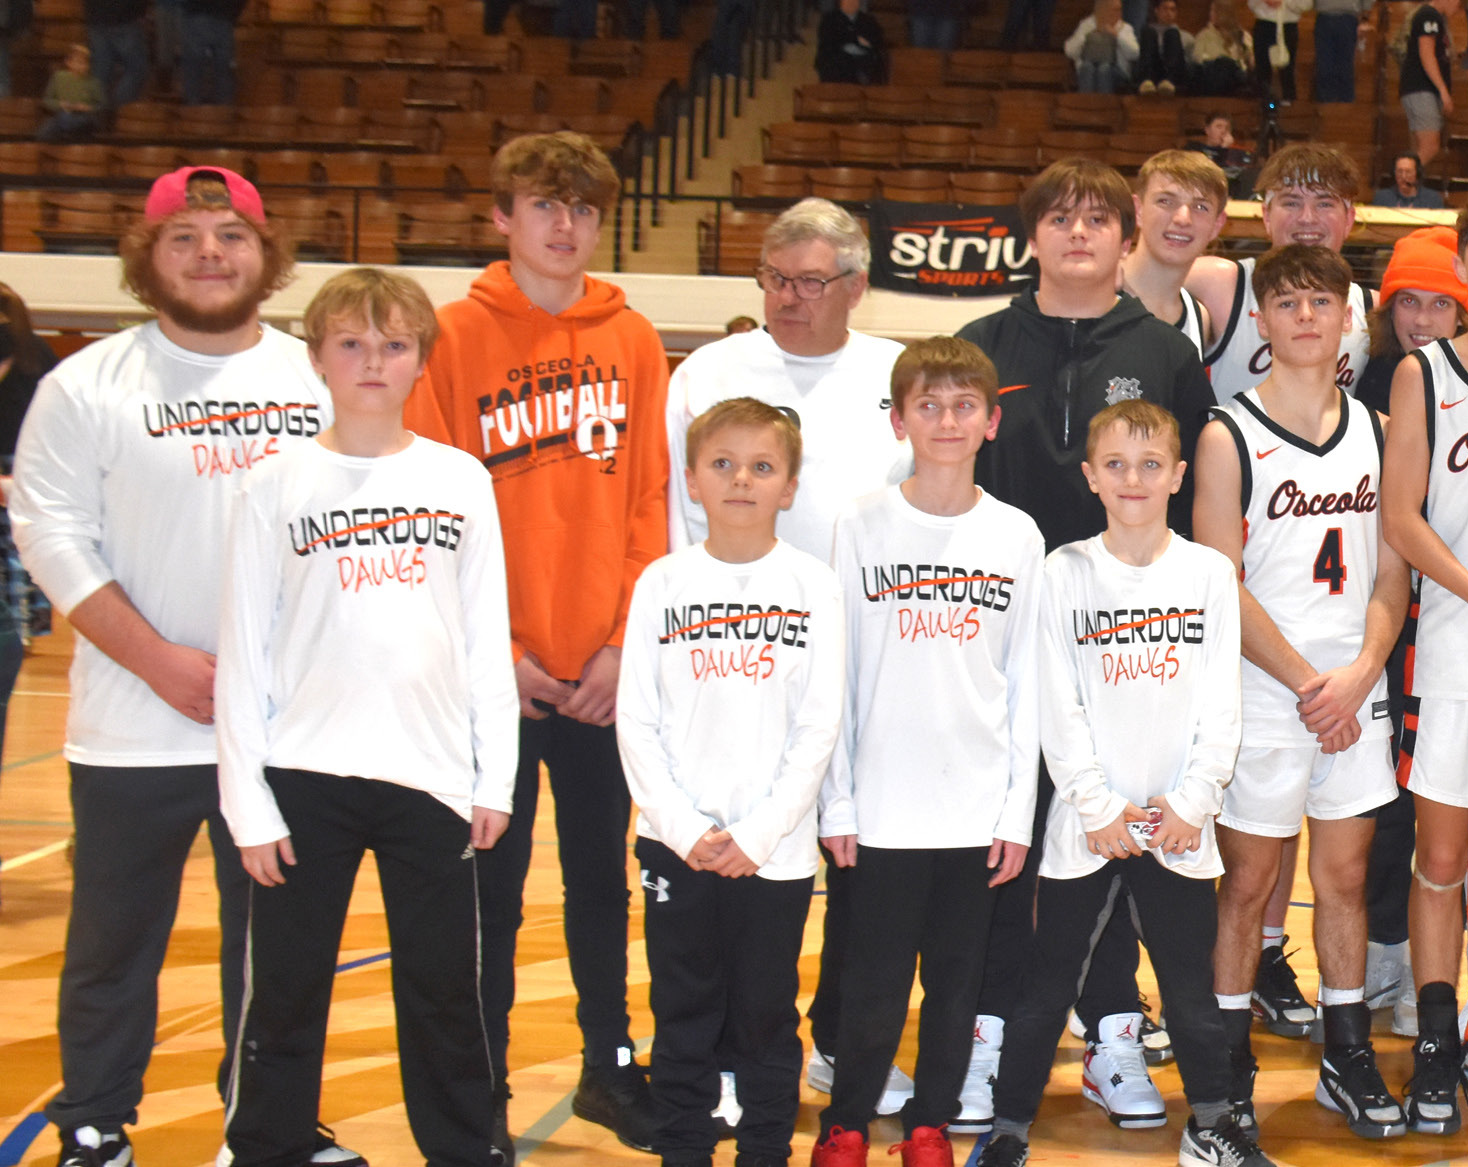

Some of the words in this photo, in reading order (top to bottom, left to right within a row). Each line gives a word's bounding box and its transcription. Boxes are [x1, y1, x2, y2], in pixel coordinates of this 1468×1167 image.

[889, 225, 1034, 271] striv
[143, 400, 320, 437] UNDERDOGS
[477, 364, 627, 455] FOOTBALL
[1267, 474, 1378, 521] Osceola
[287, 506, 465, 557] UNDERDOGS
[336, 546, 427, 593] DAWGS
[1313, 527, 1347, 596] 4
[862, 564, 1015, 612] UNDERDOGS
[898, 606, 981, 647] DAWGS
[690, 643, 776, 686] DAWGS
[1101, 644, 1181, 687] DAWGS
